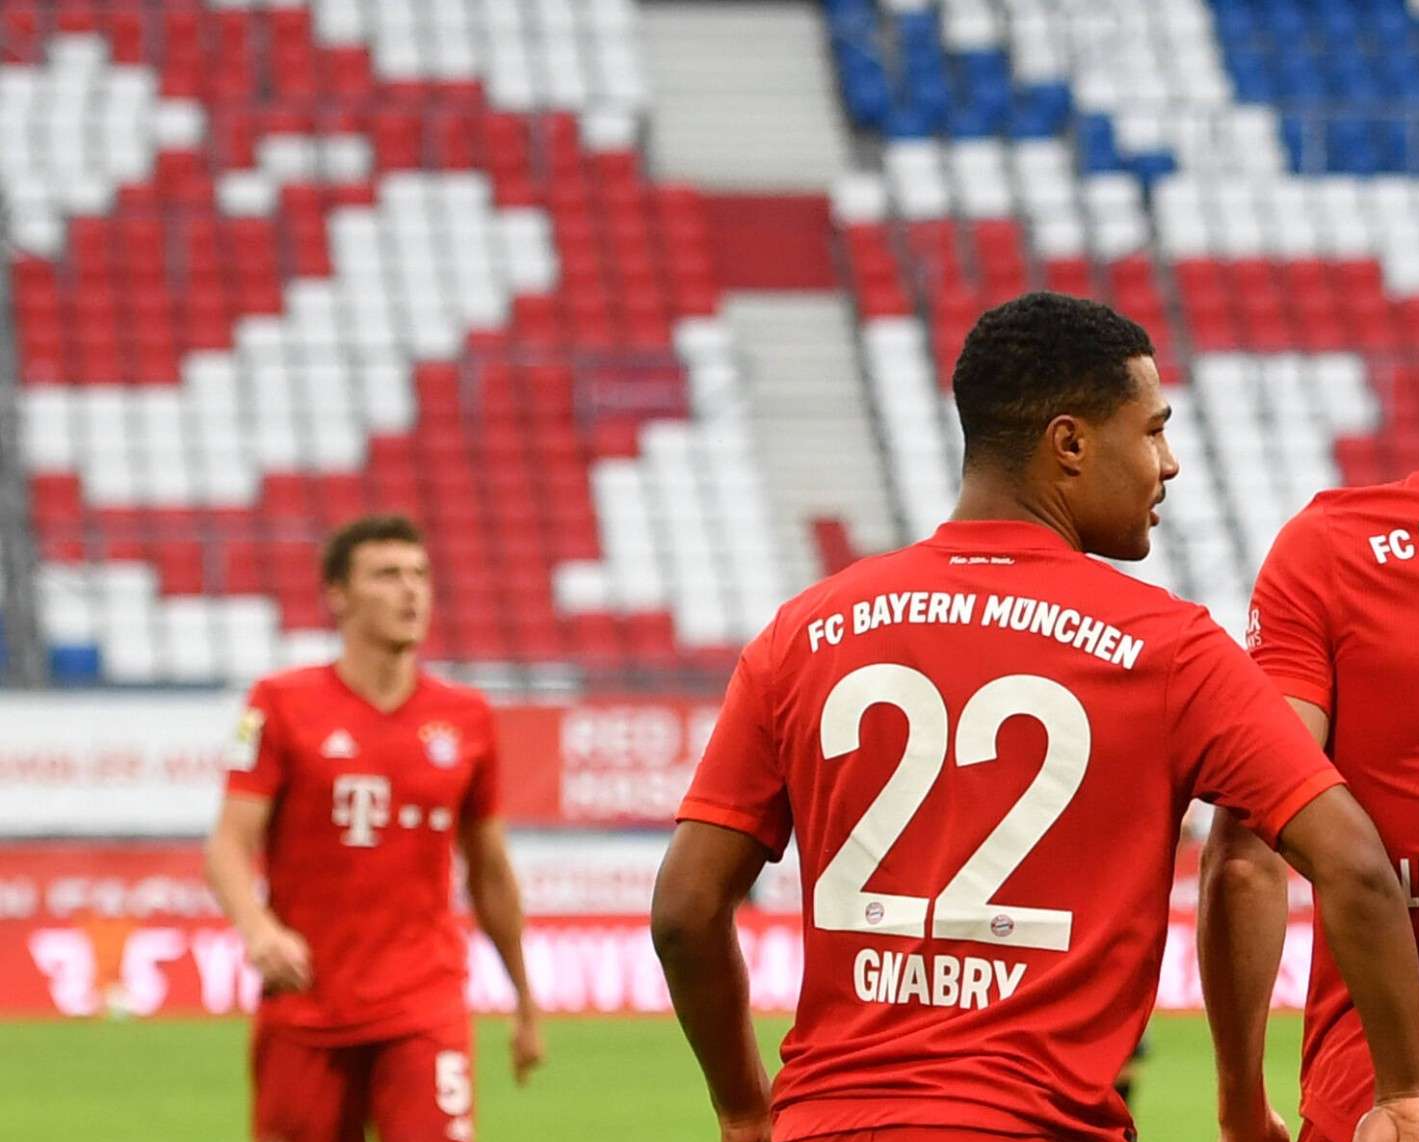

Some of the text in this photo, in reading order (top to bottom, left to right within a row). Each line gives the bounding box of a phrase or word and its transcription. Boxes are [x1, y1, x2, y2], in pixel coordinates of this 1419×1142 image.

[1369, 529, 1414, 564] FC
[807, 592, 1144, 671] FC BAYERN MÜNCHEN
[813, 663, 1092, 952] 22
[853, 948, 1028, 1010] GNABRY
